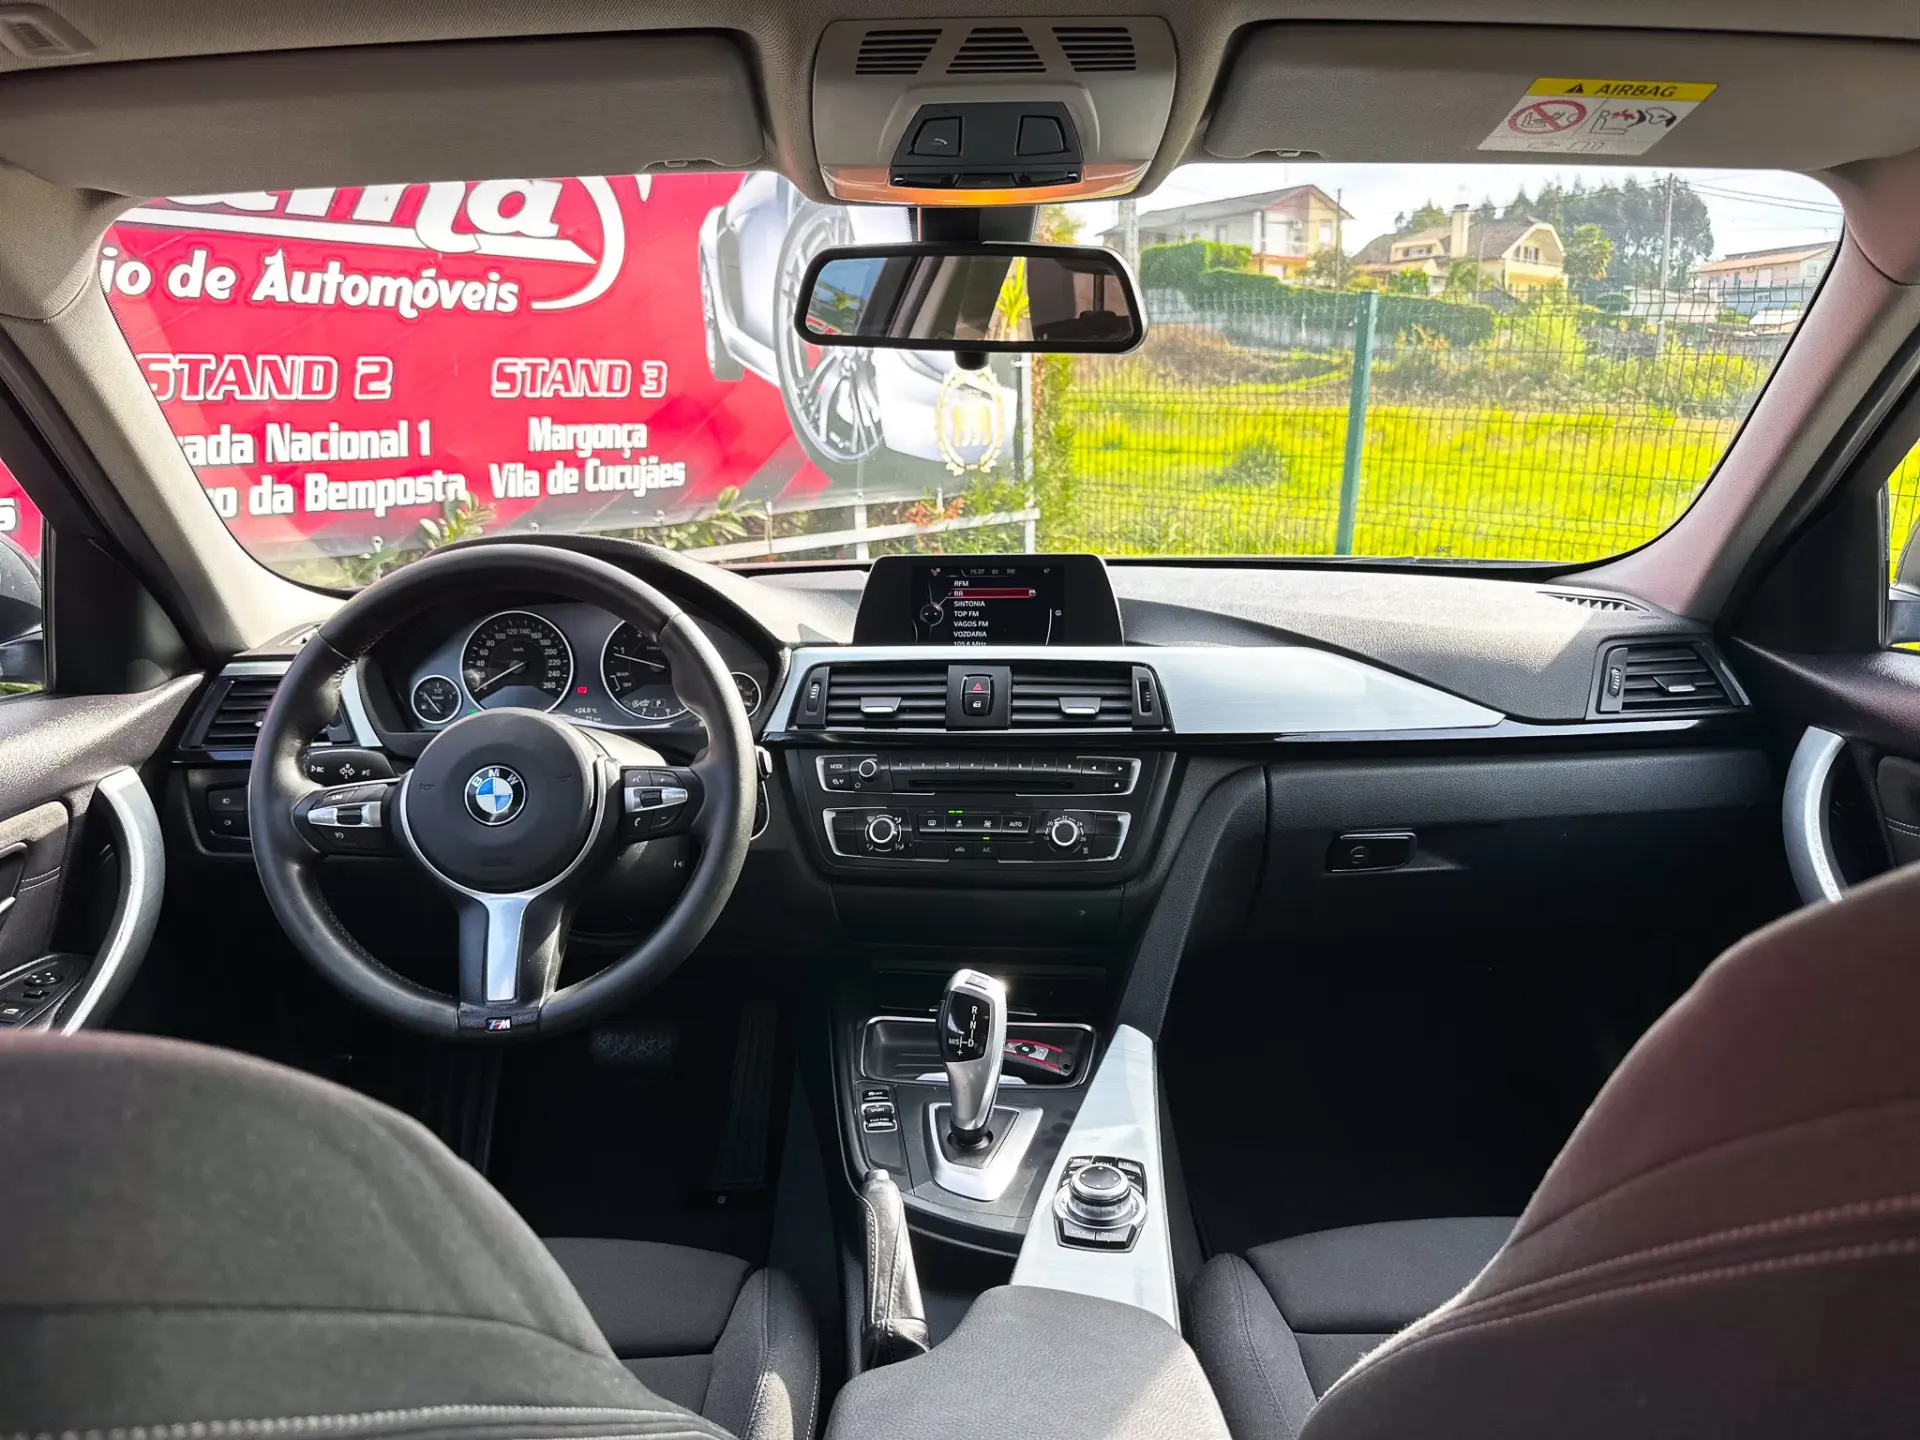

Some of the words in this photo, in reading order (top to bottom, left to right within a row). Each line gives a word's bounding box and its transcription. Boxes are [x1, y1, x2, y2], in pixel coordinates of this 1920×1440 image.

[1594, 84, 1678, 98] AIRBAG
[168, 249, 236, 300] de
[252, 248, 519, 319] Automóveis
[136, 354, 339, 401] STAND
[353, 356, 394, 400] 2
[490, 357, 632, 399] STAND
[639, 360, 668, 398] 3
[265, 419, 409, 464] Nacional
[418, 419, 431, 457] 1
[528, 416, 648, 459] Margonça
[488, 461, 540, 498] Vila
[546, 460, 579, 495] de
[250, 475, 294, 516] da
[305, 470, 467, 518] Bemposta
[953, 630, 987, 638] VOZDARIA
[480, 648, 489, 656] 60
[471, 768, 519, 788] BMW
[971, 1005, 978, 1015] R
[969, 1020, 977, 1030] N
[967, 1038, 975, 1047] D
